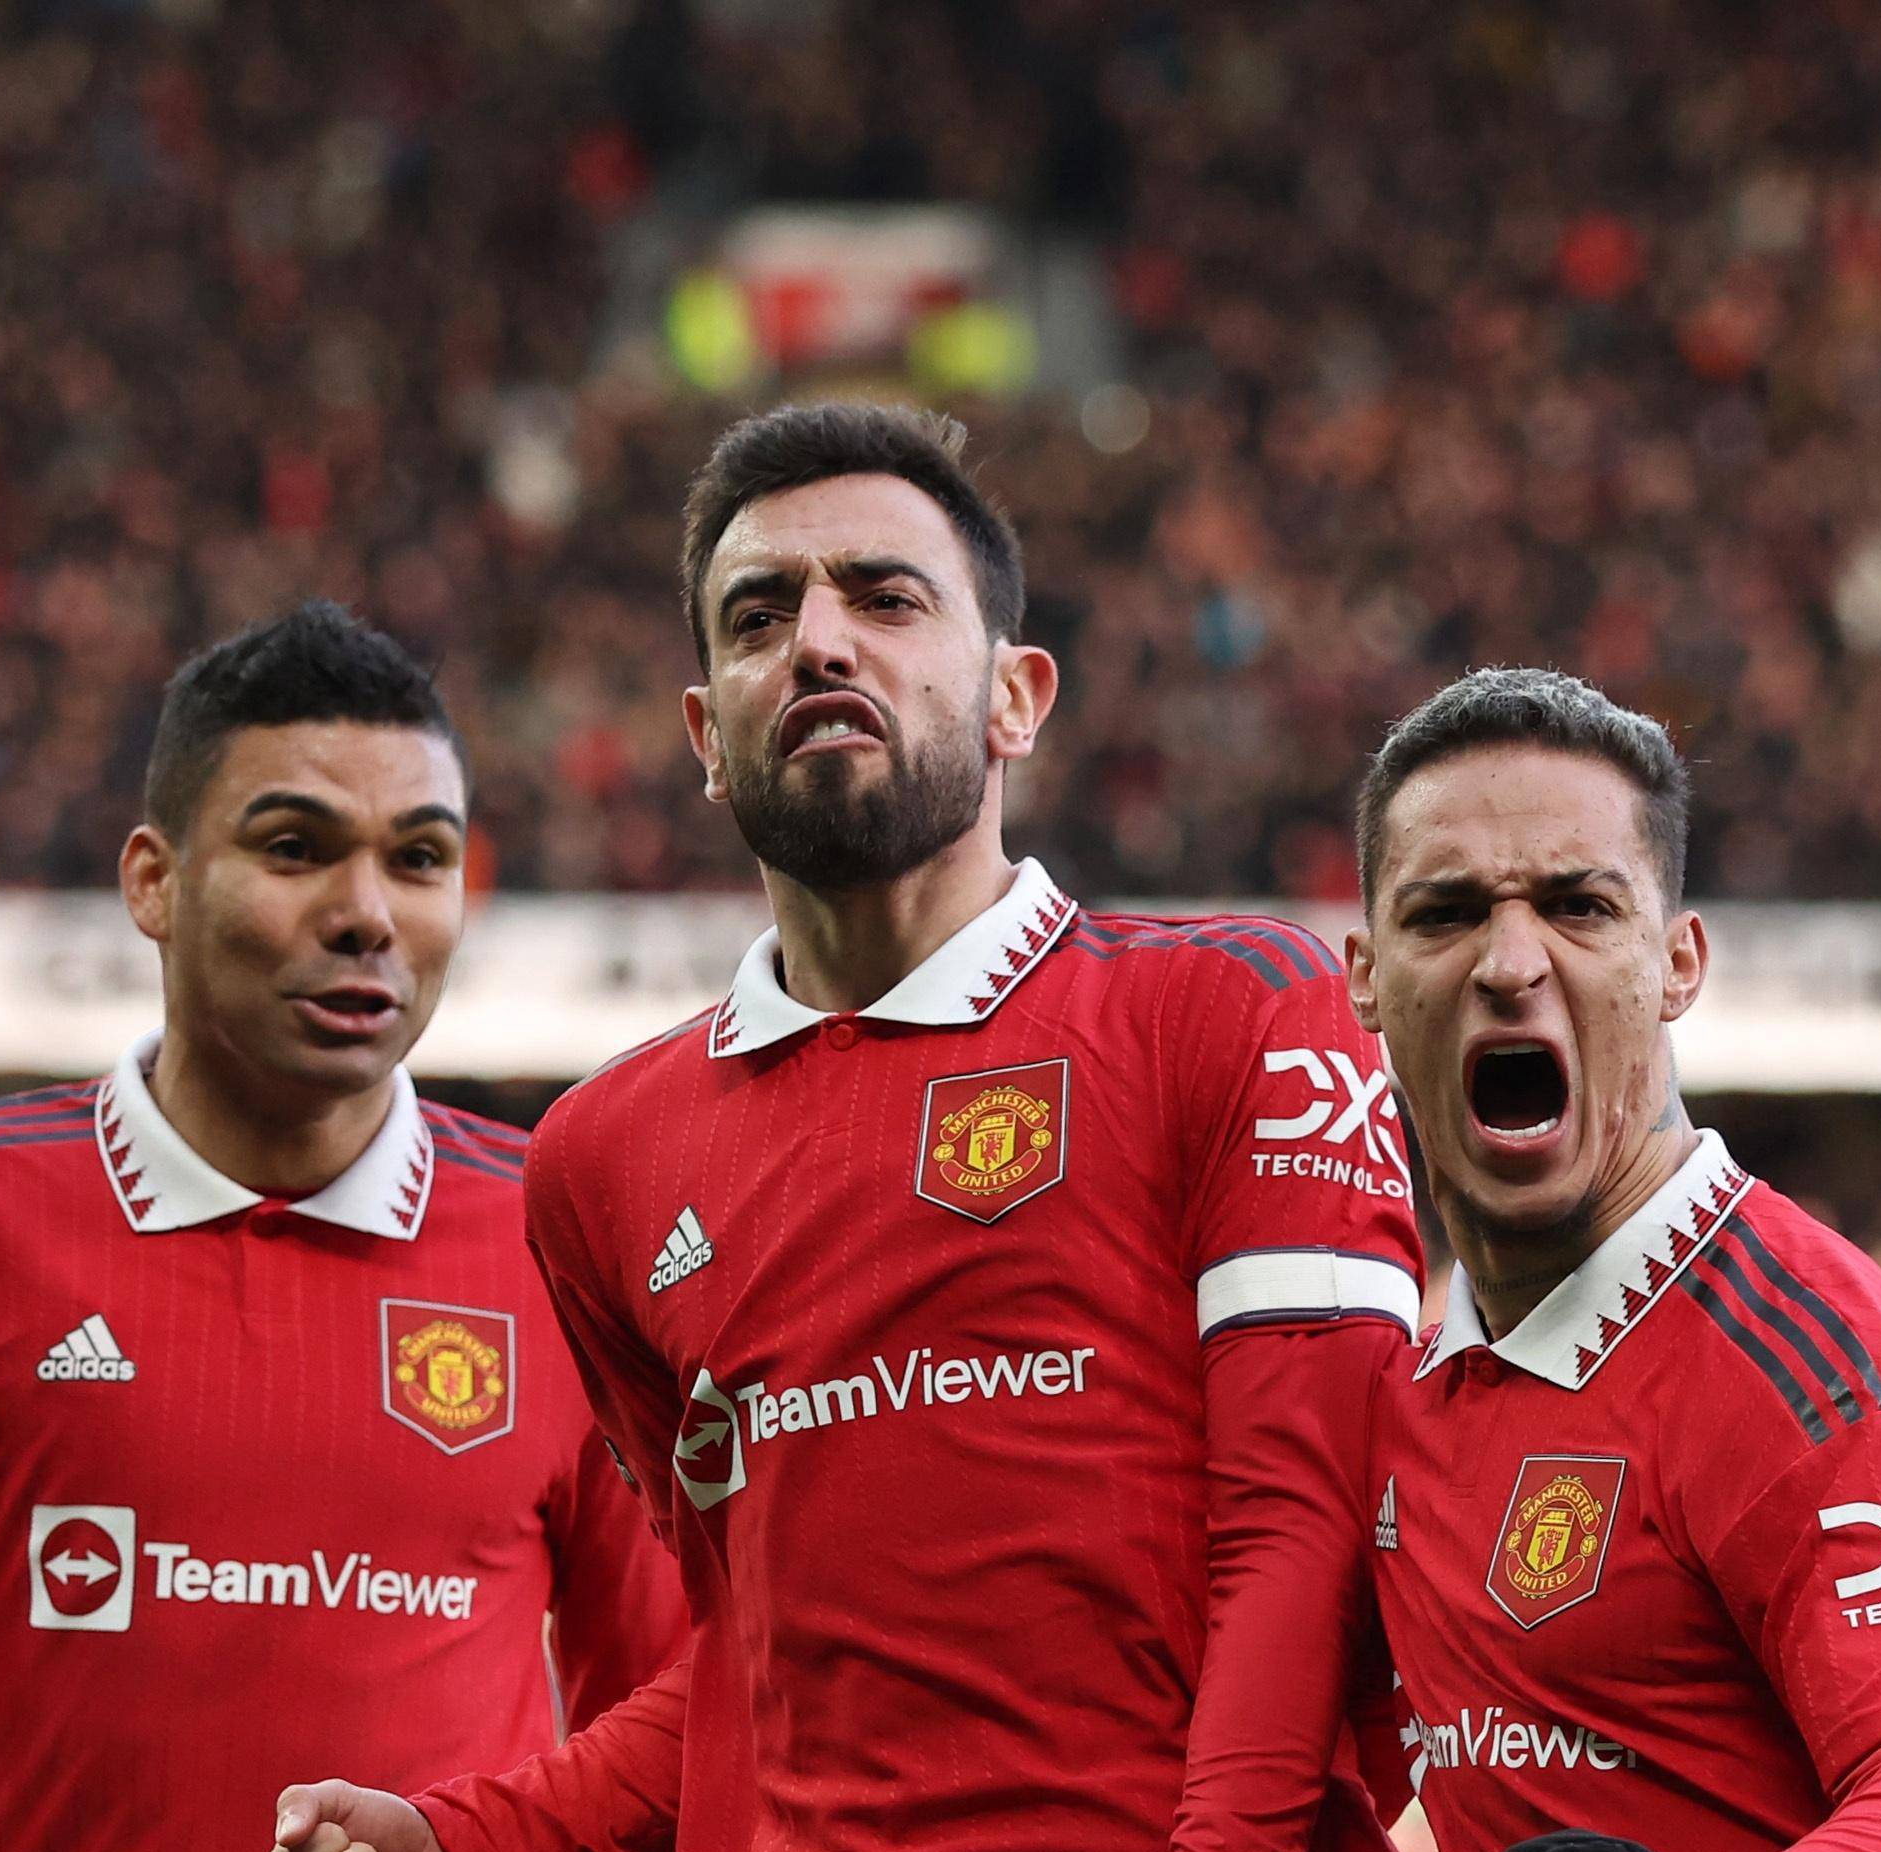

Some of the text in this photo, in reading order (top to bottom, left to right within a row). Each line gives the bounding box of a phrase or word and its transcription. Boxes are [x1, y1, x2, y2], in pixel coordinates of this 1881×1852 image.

[948, 1093, 1041, 1135] MANCHESTER
[957, 1165, 1024, 1187] UNITED
[1251, 1153, 1414, 1212] TECHNOLO
[647, 1239, 714, 1294] adidas
[37, 1356, 136, 1381] adidas
[735, 1346, 1096, 1444] TeamViewer
[1522, 1484, 1595, 1526] MANCHESTER
[143, 1542, 478, 1620] TeamViewer
[1514, 1567, 1567, 1590] UNITED
